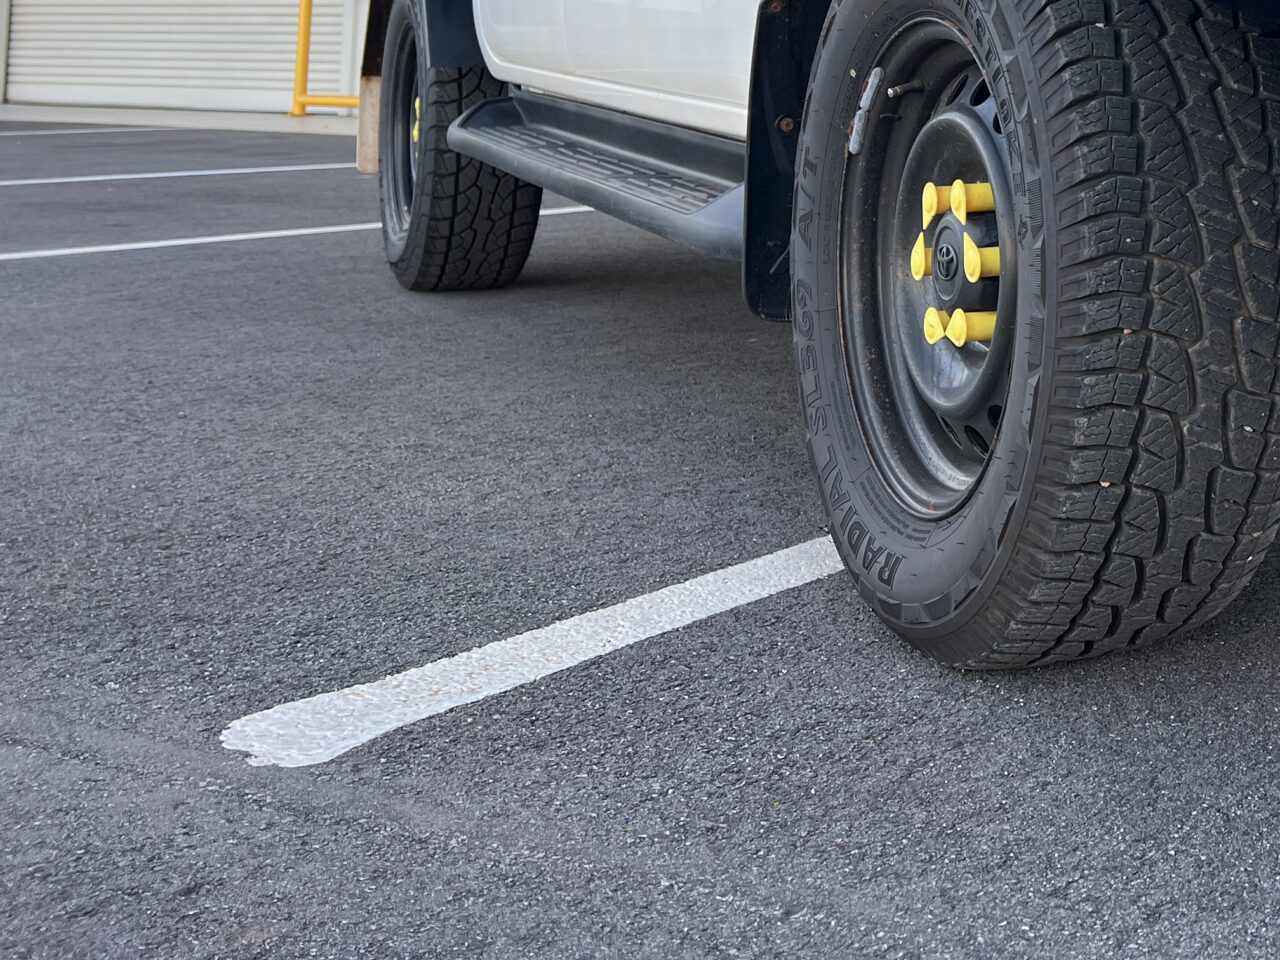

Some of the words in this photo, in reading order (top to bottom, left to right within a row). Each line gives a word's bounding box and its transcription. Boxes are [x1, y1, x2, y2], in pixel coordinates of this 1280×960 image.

[797, 145, 818, 253] A/T
[796, 278, 828, 436] SL369
[821, 442, 905, 591] RADIAL
